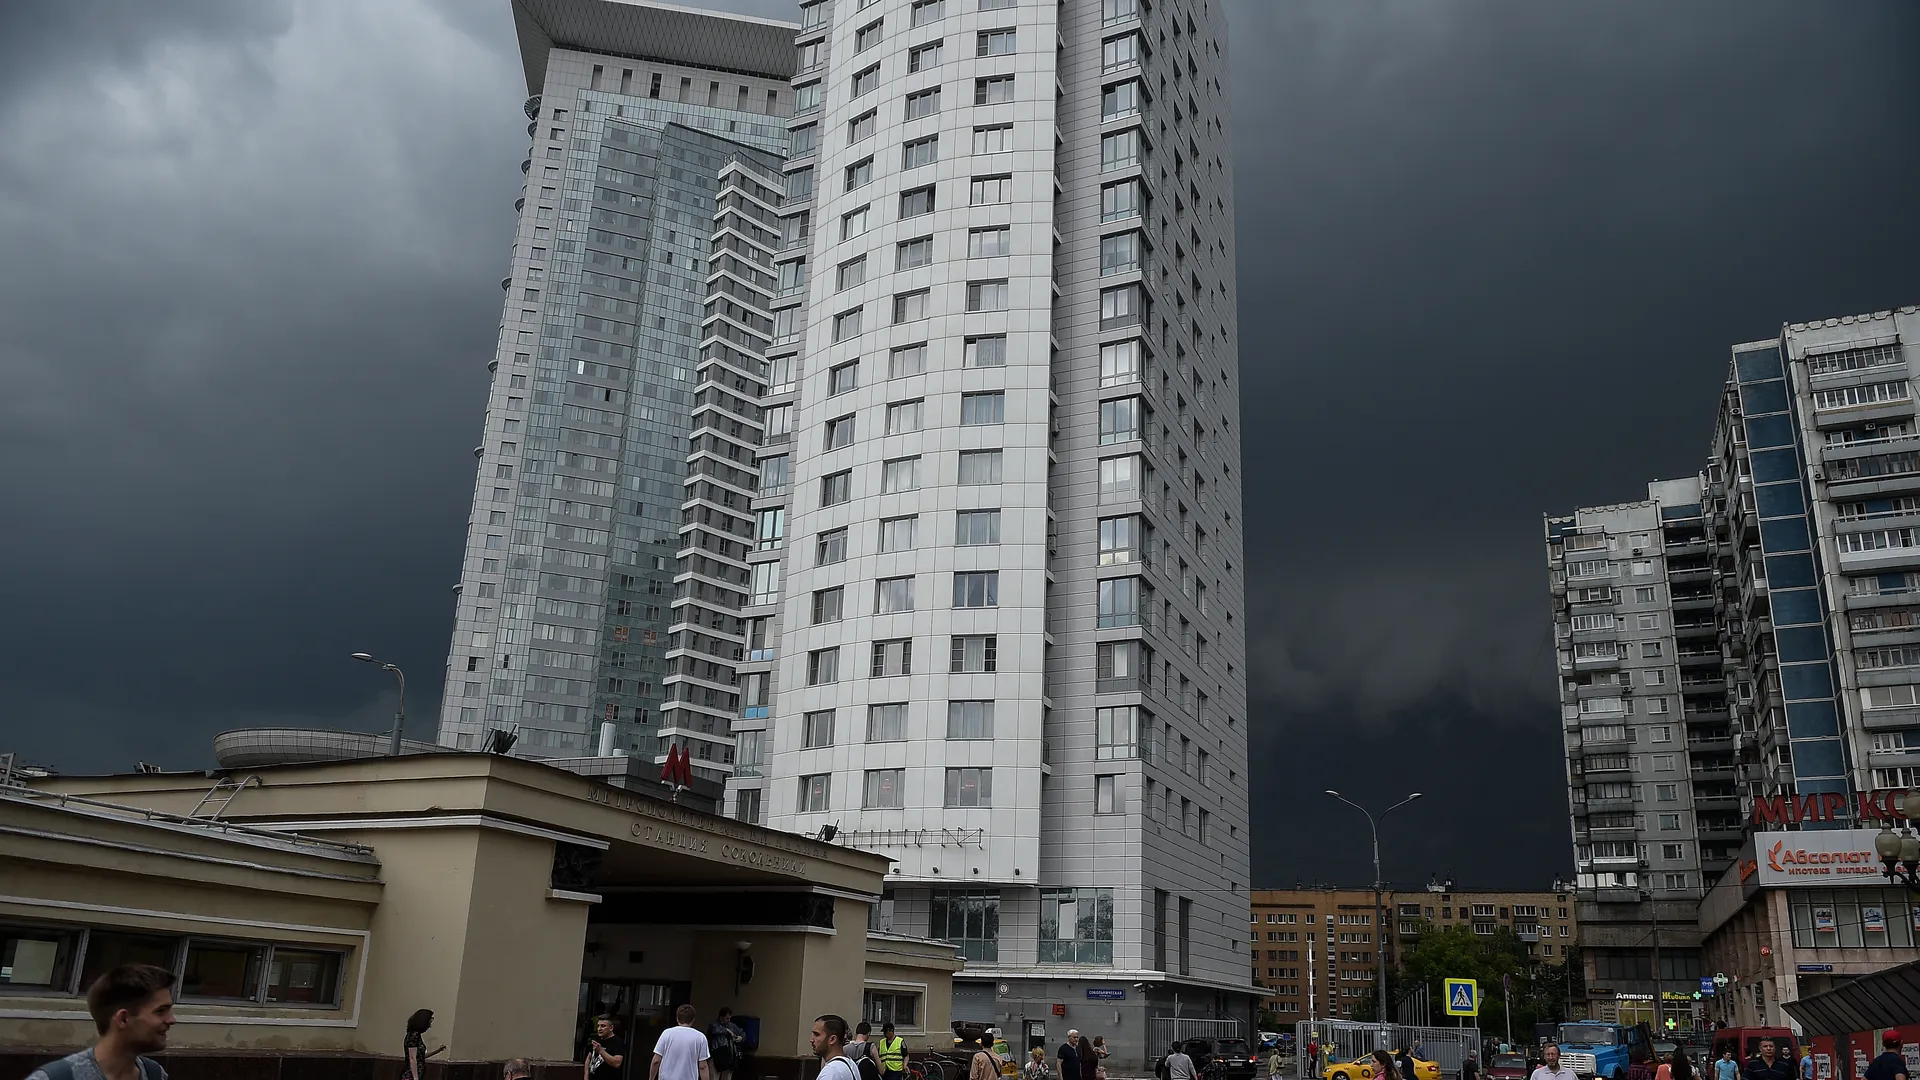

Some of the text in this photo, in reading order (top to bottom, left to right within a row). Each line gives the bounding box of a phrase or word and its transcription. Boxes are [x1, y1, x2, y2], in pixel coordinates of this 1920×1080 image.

[660, 743, 693, 788] М
[587, 785, 716, 832] МЕТРОПОЛИТЕН
[1753, 792, 1847, 824] МИР
[630, 822, 807, 875] СТАНЦИЯ СОКОЛЬНИКИ
[1782, 849, 1872, 864] Абсолют
[1788, 867, 1831, 876] ипотека
[1836, 866, 1878, 875] вклады
[1615, 992, 1654, 1000] Аптека
